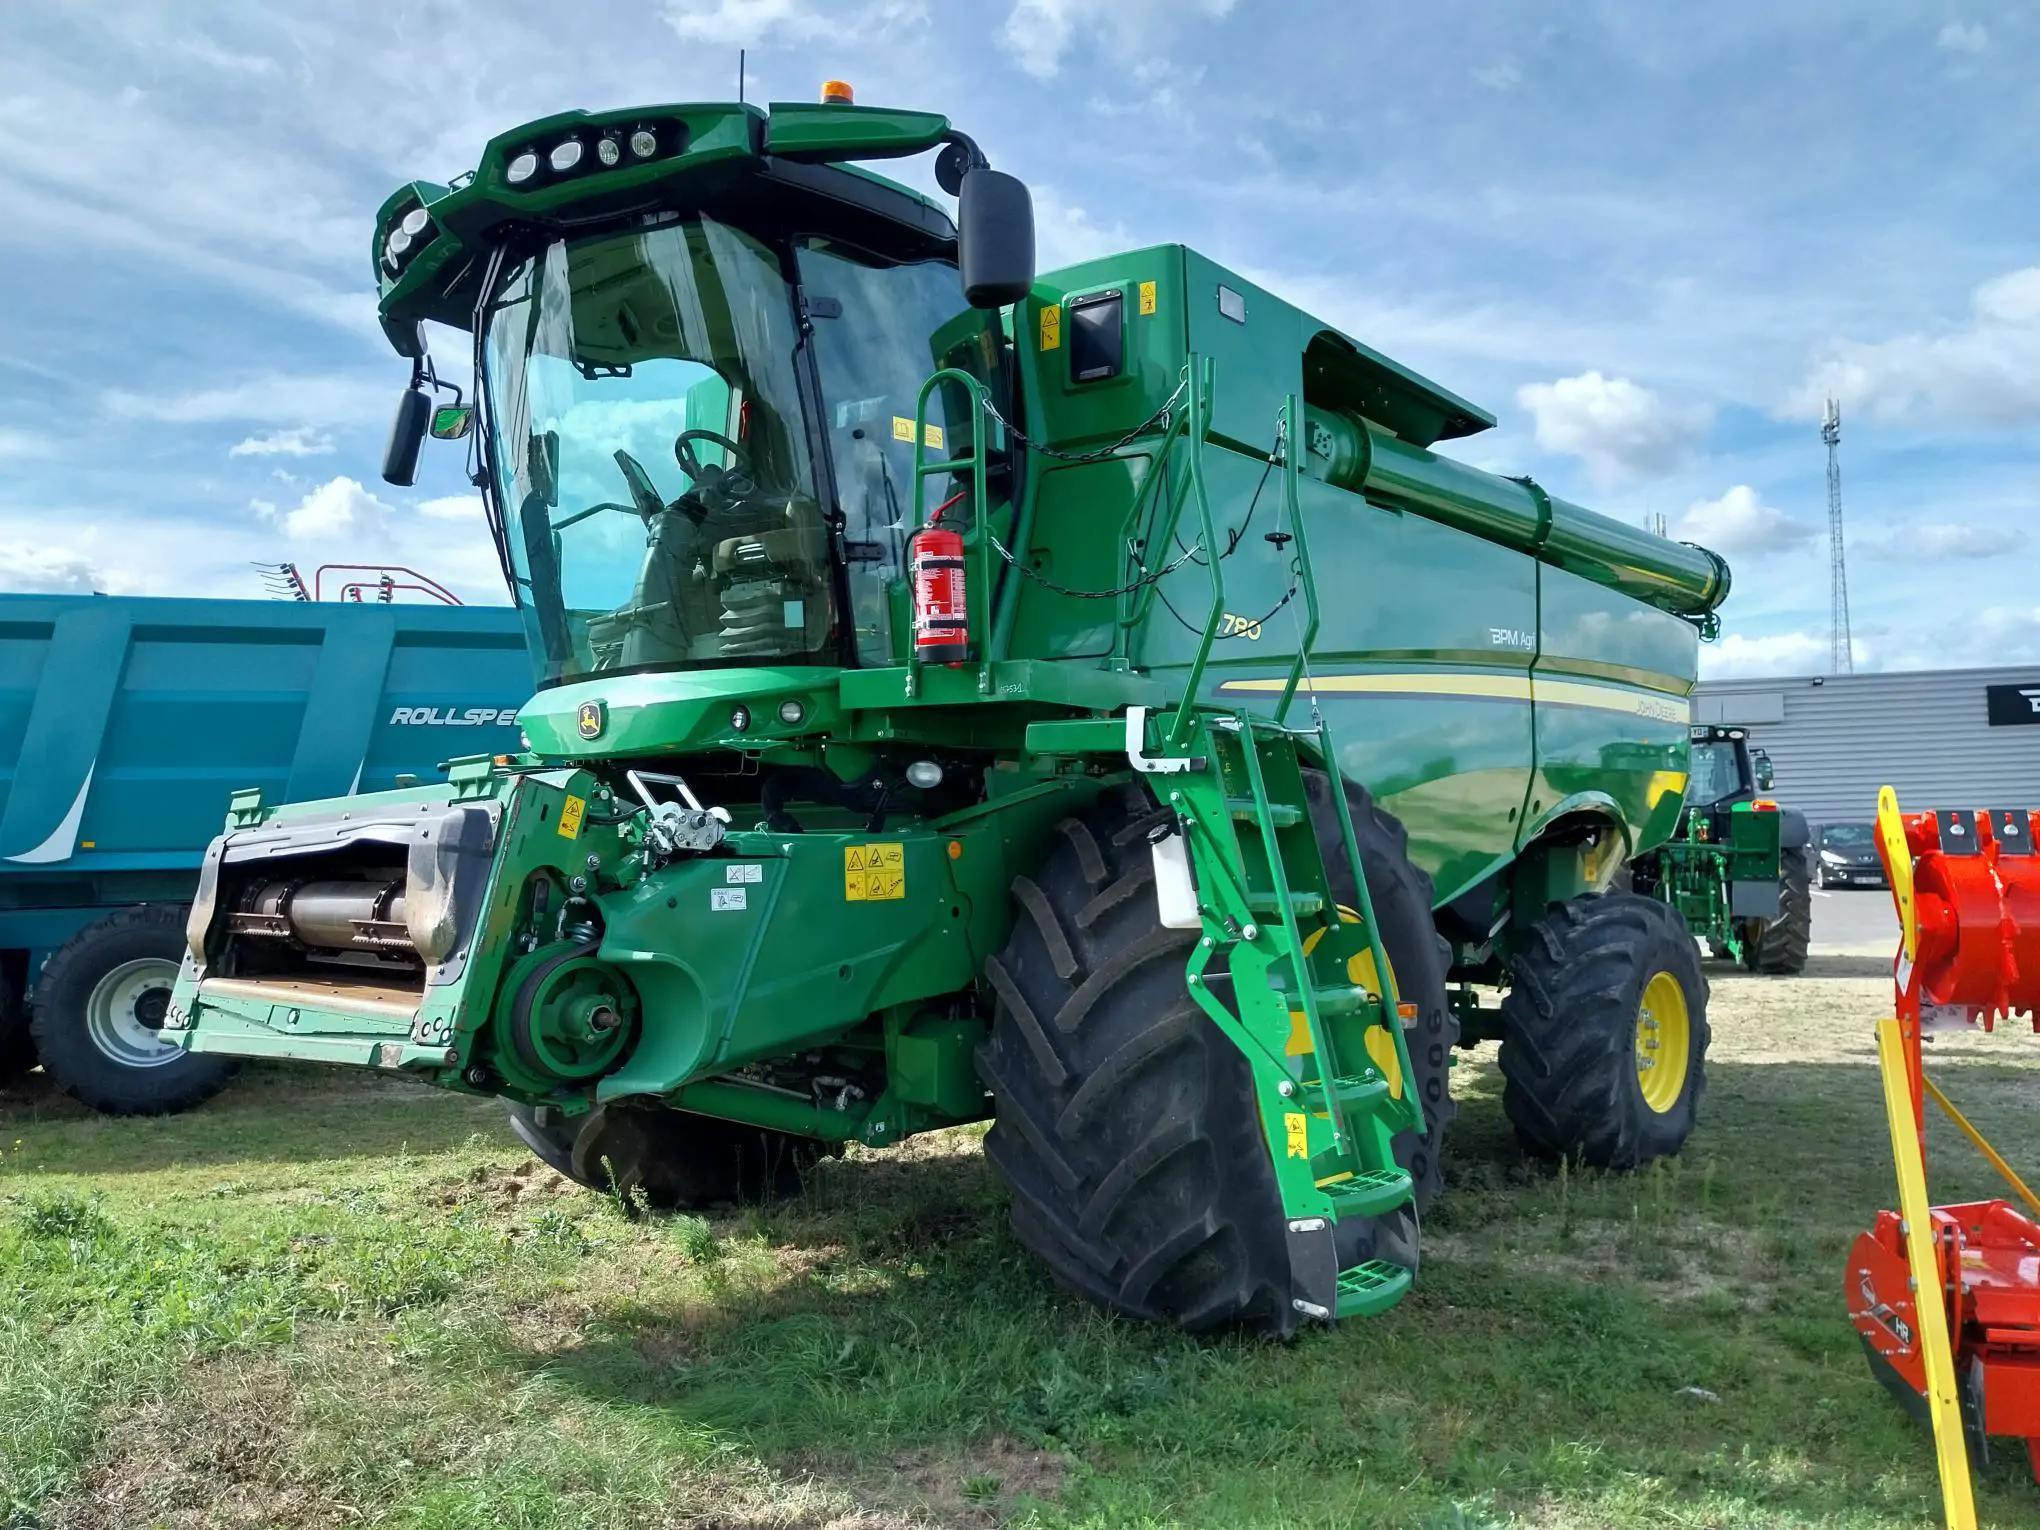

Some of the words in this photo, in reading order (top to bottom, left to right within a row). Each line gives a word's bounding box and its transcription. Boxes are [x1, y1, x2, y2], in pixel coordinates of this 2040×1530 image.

[1223, 612, 1263, 640] 780
[1489, 628, 1518, 646] BPM
[1520, 631, 1536, 650] Agri
[389, 707, 524, 726] ROLLSPE
[1636, 698, 1655, 717] JOHN
[1655, 701, 1677, 721] DEERE
[1895, 1316, 1910, 1344] HR
